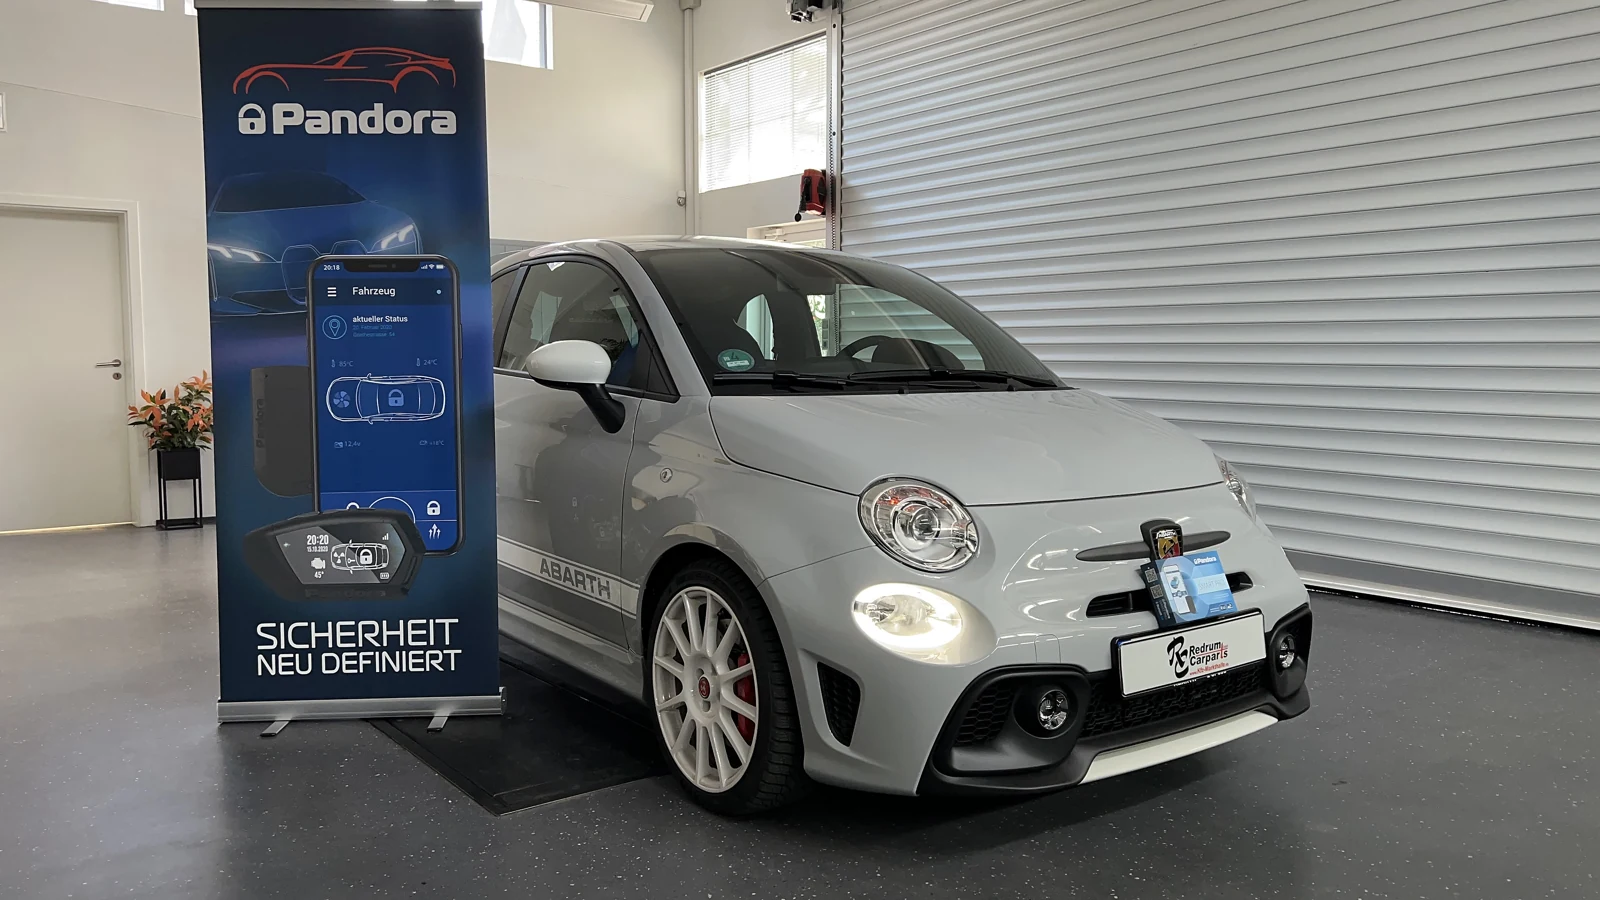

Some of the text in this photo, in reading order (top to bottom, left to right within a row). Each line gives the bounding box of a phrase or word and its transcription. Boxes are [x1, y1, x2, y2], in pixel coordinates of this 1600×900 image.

[272, 103, 457, 135] Pandora
[352, 286, 396, 297] Fahrzeug
[352, 315, 408, 323] aktueller Status
[306, 534, 329, 546] 20:20
[540, 558, 611, 600] ABARTH
[256, 618, 459, 650] SICHERHEIT
[1189, 641, 1222, 658] Redrum
[1190, 645, 1229, 666] Carparts
[257, 649, 463, 676] NEU DEFINIERT
